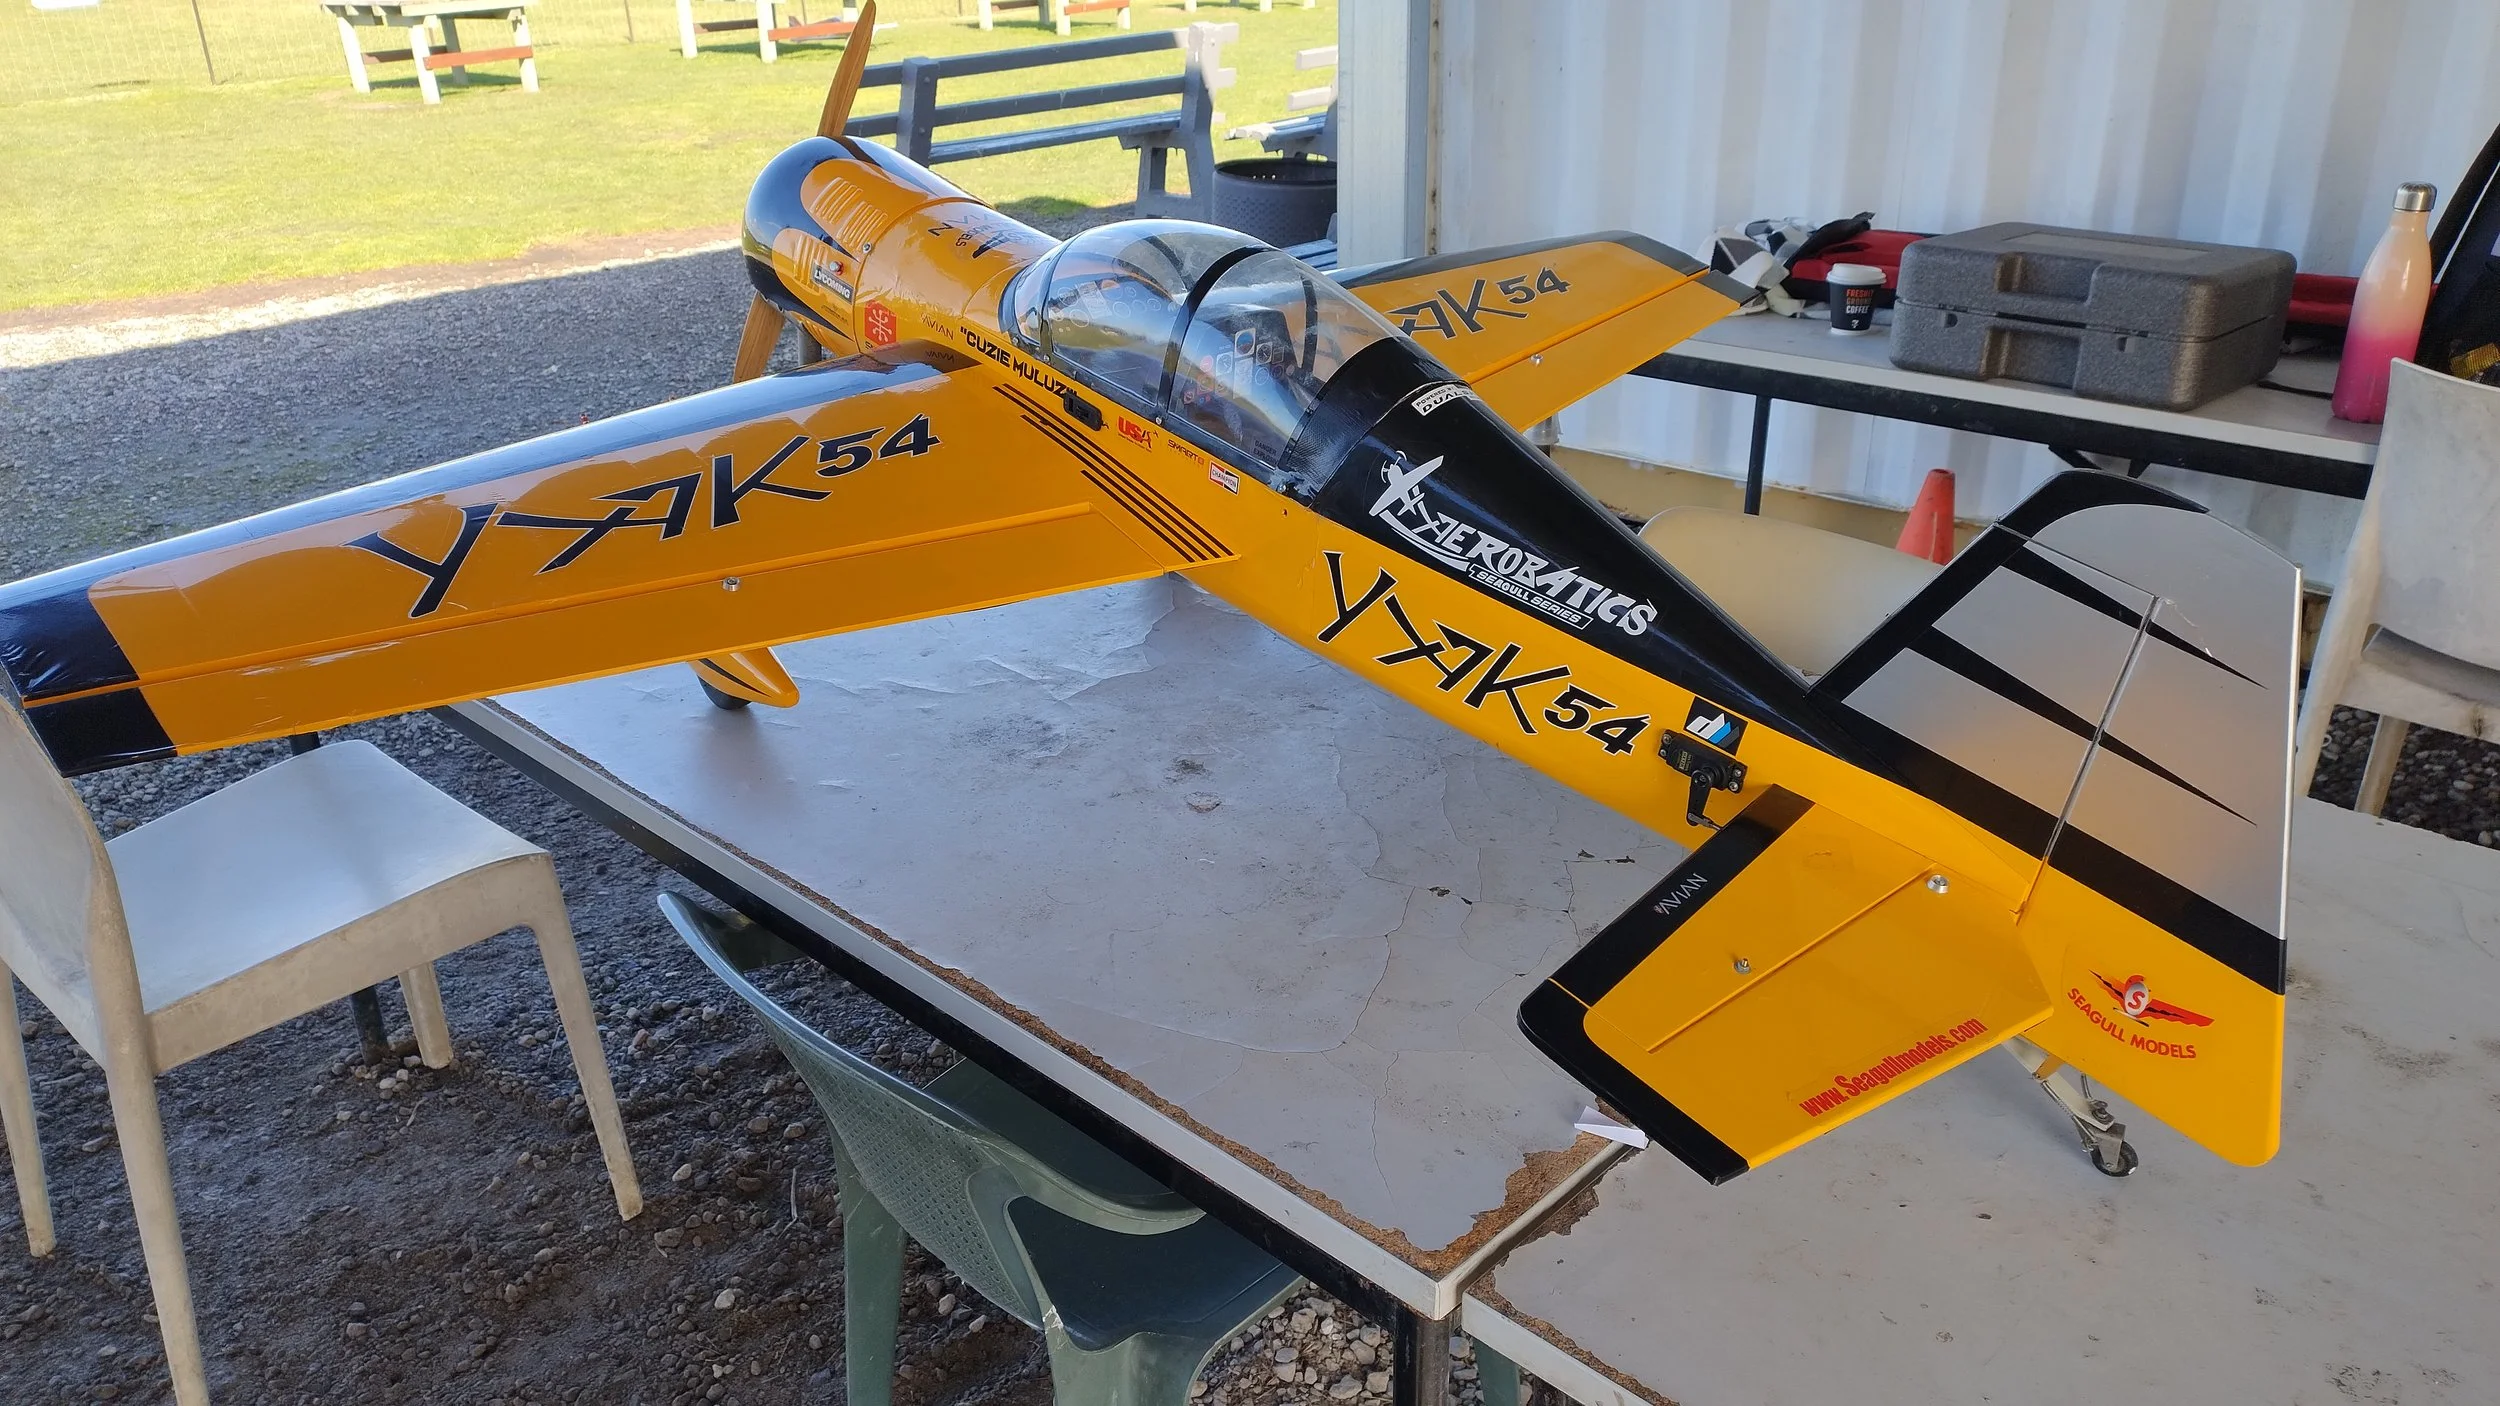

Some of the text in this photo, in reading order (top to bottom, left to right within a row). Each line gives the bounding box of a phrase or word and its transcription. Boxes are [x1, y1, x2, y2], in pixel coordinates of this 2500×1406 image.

[814, 269, 851, 299] LYCOMING
[1494, 266, 1573, 305] 54
[922, 314, 955, 341] AVIAN
[960, 326, 1011, 368] "CUZIE
[1416, 389, 1447, 407] POWERED
[1211, 468, 1238, 490] CHAMPION
[342, 413, 941, 619] YAK 54
[1475, 570, 1582, 625] SEAGULL SERIES
[1317, 549, 1652, 757] YAK 54
[1659, 872, 1708, 915] AVIAN
[2126, 991, 2147, 1010] S
[2067, 987, 2198, 1060] SEAGULL MODELS
[1799, 1016, 1989, 1119] www.Seagullmodels.com
